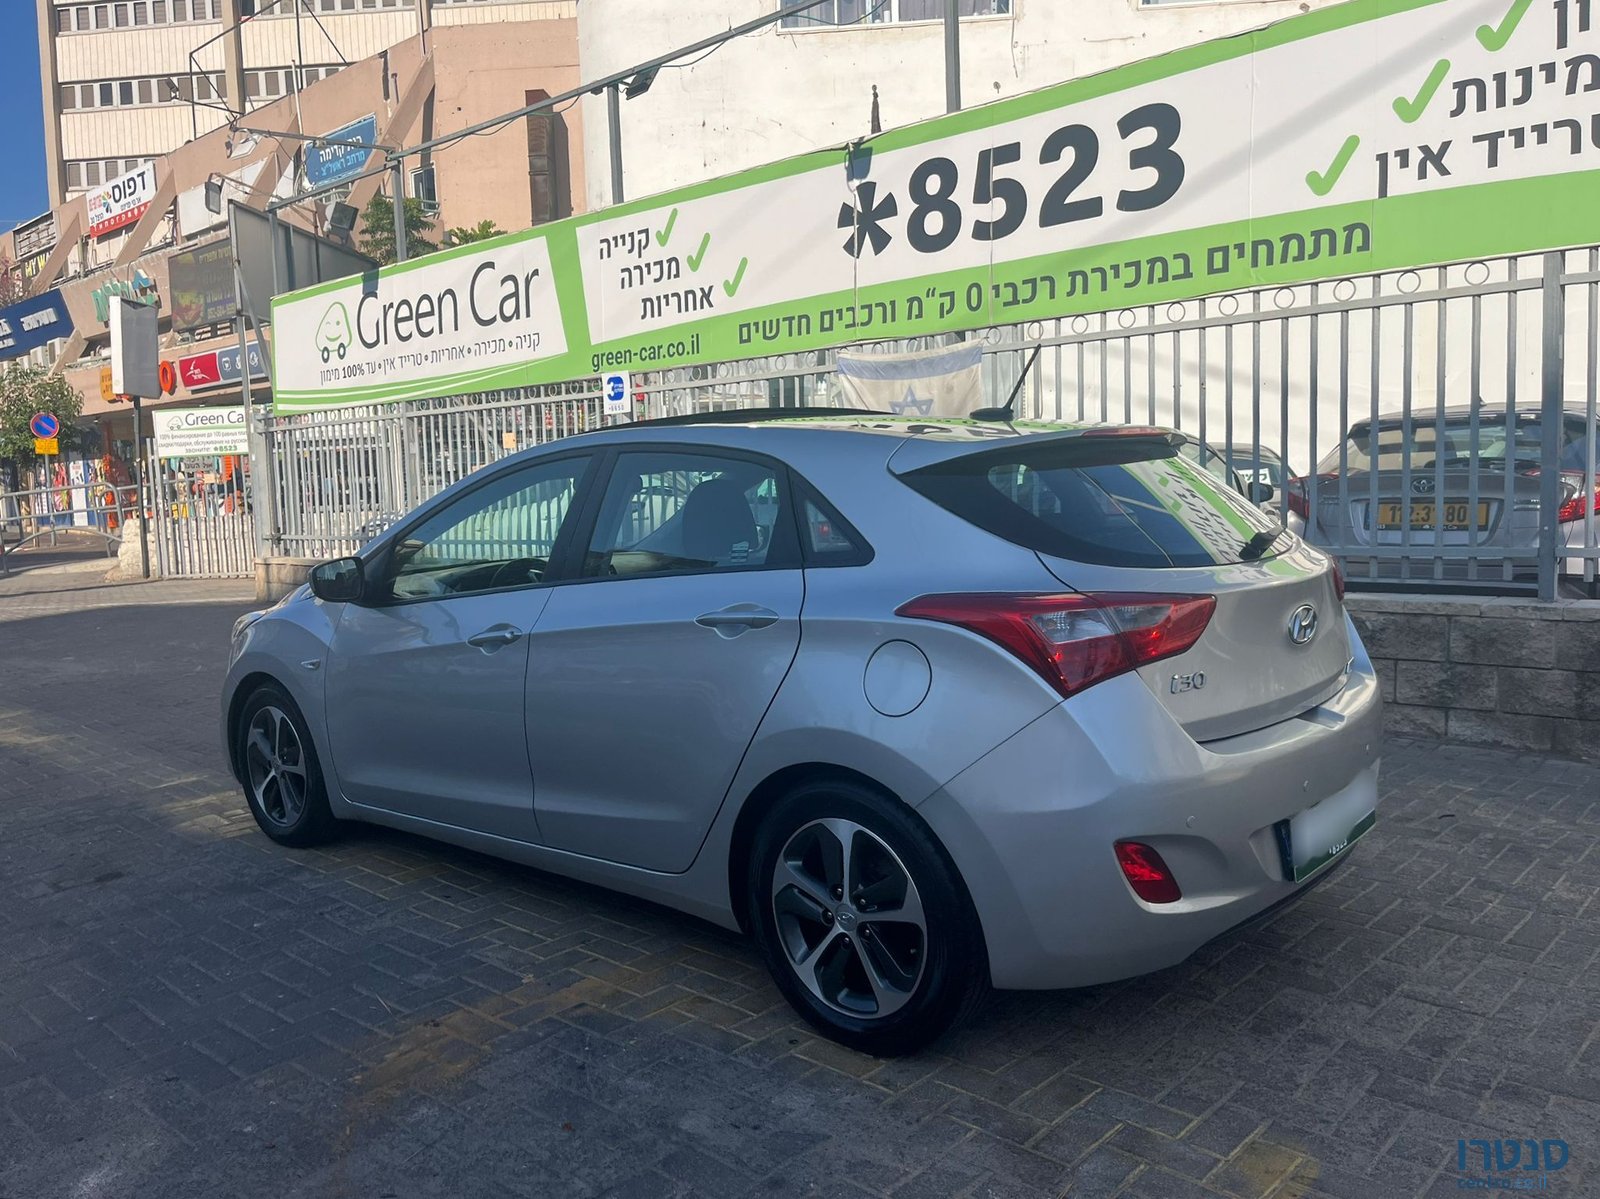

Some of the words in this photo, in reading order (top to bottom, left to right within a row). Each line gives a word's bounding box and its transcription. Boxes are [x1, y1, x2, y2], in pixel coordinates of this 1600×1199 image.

[320, 145, 344, 162] קדימה
[1472, 113, 1600, 168] רייד
[346, 151, 365, 166] מרחב
[1376, 139, 1453, 199] אין
[111, 170, 146, 203] דפוס
[599, 228, 650, 260] קנייה
[1207, 222, 1371, 275] מתמחים
[620, 256, 681, 290] מכירה
[1066, 252, 1193, 297] במכירת
[357, 288, 459, 349] Green
[470, 261, 539, 327] Car
[641, 285, 714, 320] אחריות
[966, 282, 983, 312] 0
[992, 275, 1056, 307] רכבי
[739, 313, 811, 344] חדשים
[820, 300, 896, 333] ורכבים
[430, 345, 465, 364] אחריות
[474, 338, 506, 357] מכירה
[515, 332, 541, 352] קניה
[592, 333, 700, 372] green-car.co.il
[342, 363, 365, 379] 100%
[365, 361, 377, 375] עד
[383, 358, 396, 375] אין
[398, 352, 422, 368] טרייד
[320, 367, 340, 386] מימון
[185, 413, 224, 426] Green
[227, 411, 244, 424] Ca
[1171, 671, 1206, 694] i30
